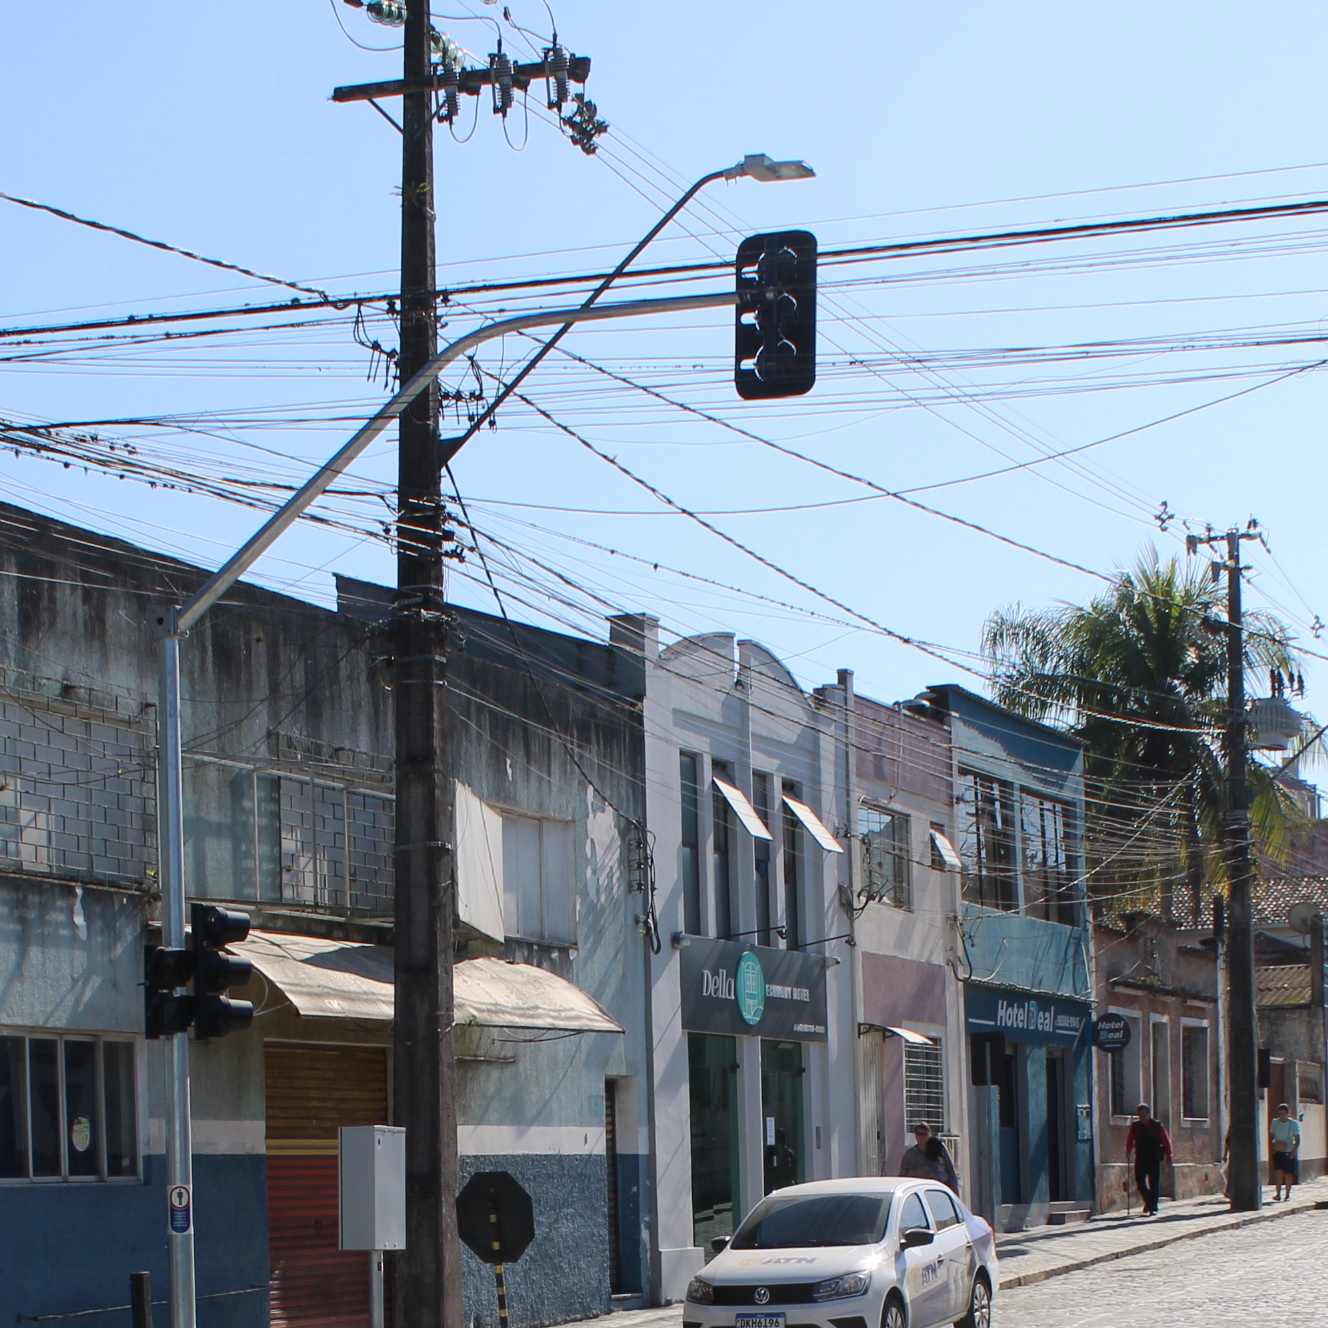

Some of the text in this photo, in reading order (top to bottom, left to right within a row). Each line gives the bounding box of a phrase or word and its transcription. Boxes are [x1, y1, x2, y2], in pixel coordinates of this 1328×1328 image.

[702, 969, 735, 1000] Della
[997, 1000, 1028, 1029] Hotel
[1098, 1020, 1125, 1030] Hotel
[1099, 1030, 1124, 1040] Deal
[740, 1318, 780, 1328] DKH6196
